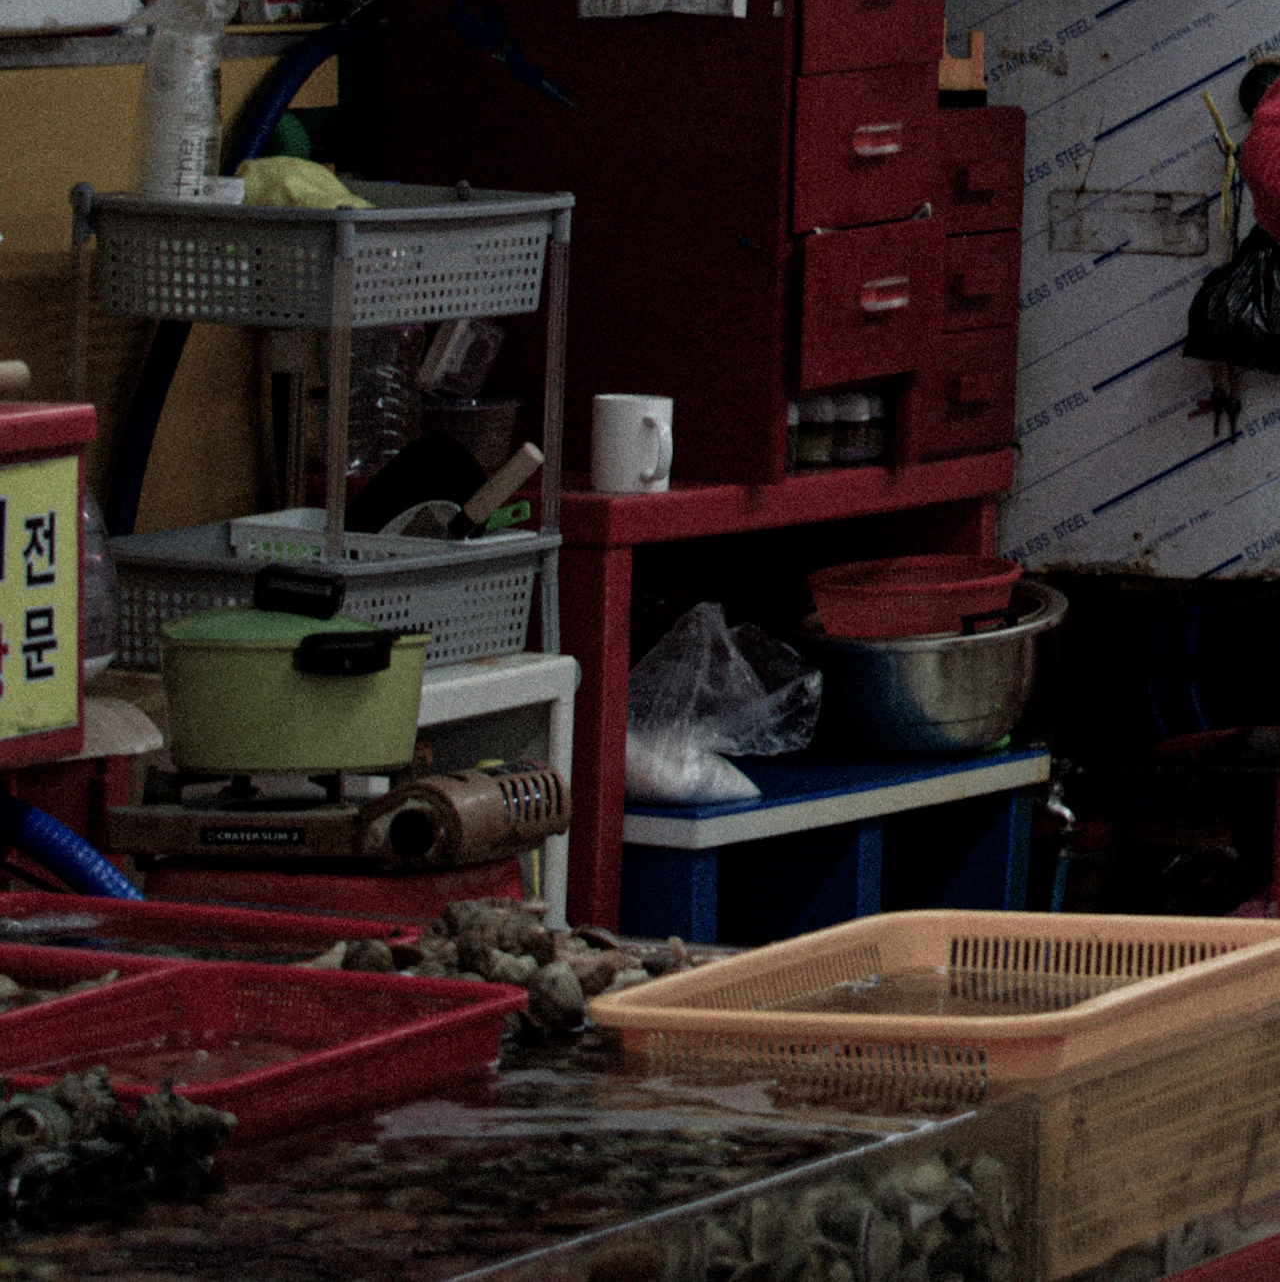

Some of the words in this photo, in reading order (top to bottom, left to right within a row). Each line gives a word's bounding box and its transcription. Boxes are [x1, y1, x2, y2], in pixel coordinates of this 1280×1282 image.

[987, 35, 1054, 84] STAINLESS
[1056, 18, 1093, 46] STEEL
[1054, 140, 1092, 168] STEEL
[1054, 264, 1091, 293] STEEL
[1053, 390, 1090, 418] STEEL
